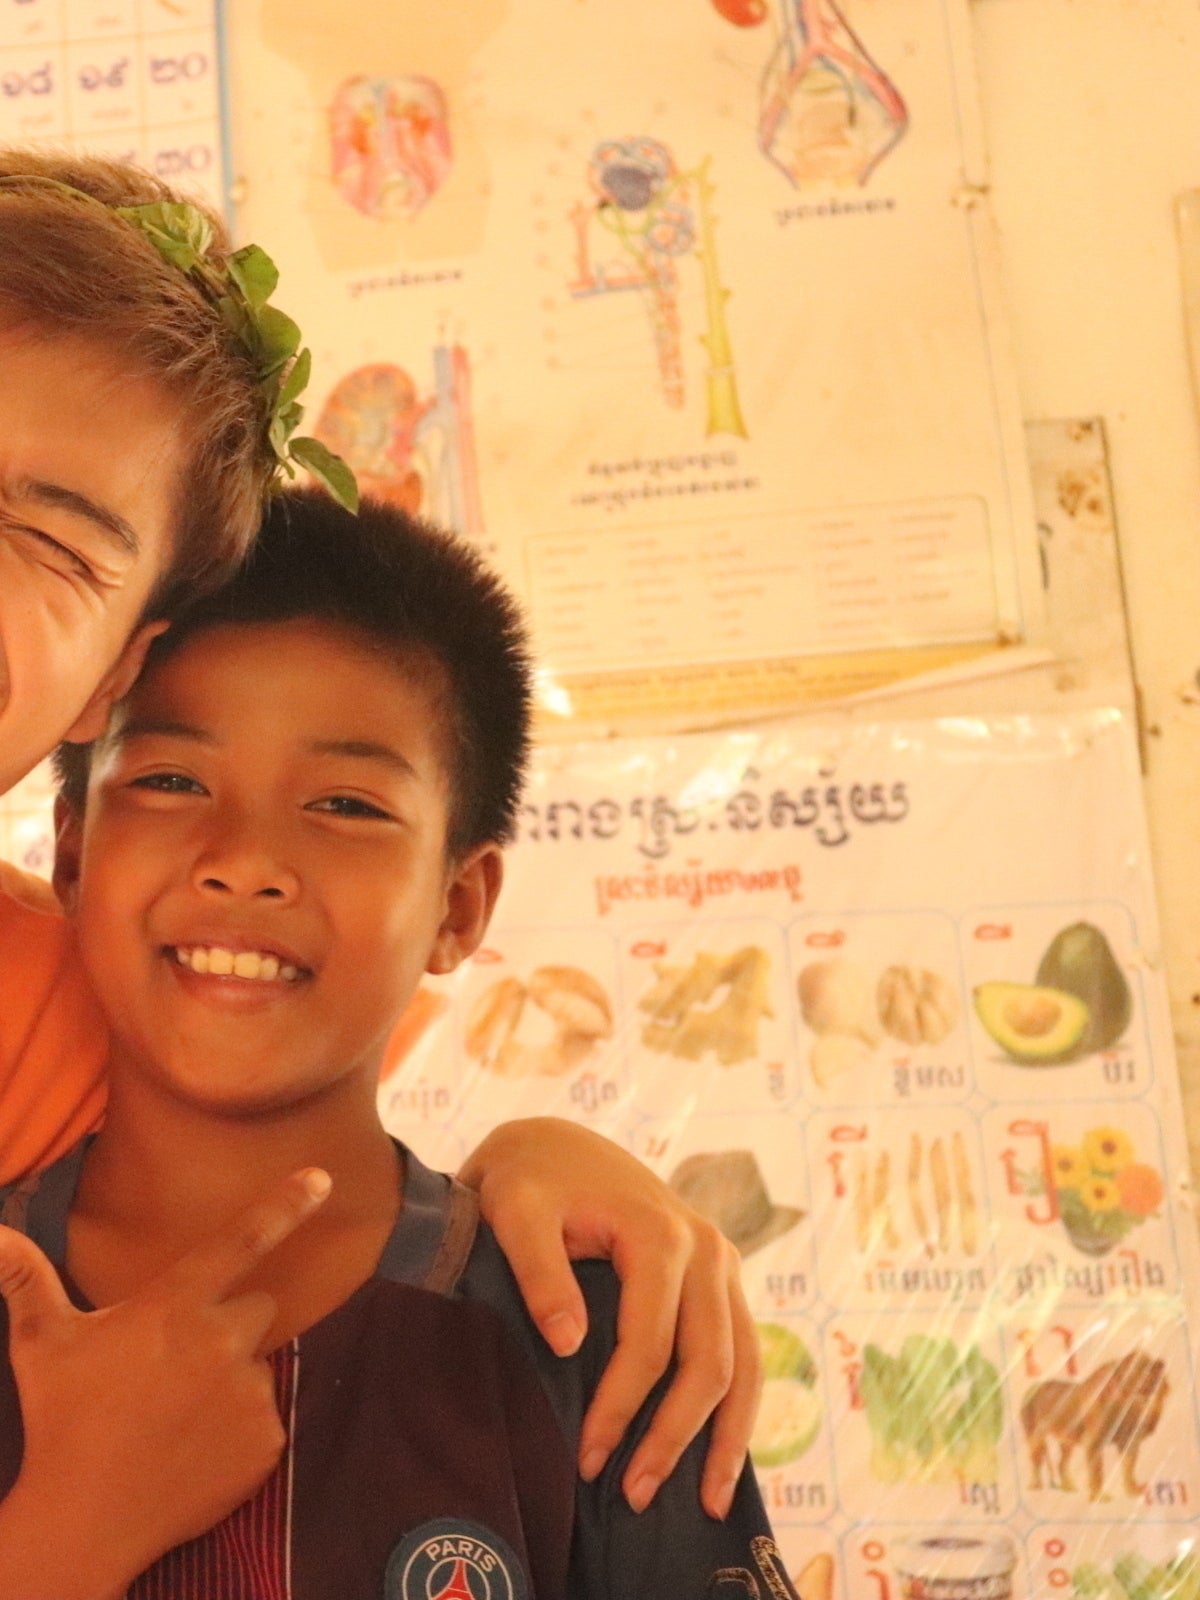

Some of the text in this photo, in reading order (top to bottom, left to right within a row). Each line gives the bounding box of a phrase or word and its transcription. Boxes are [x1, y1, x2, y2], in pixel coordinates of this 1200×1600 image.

[1, 60, 54, 98] ១៨
[78, 55, 130, 91] ១៩
[149, 51, 208, 84] ២០
[154, 145, 212, 176] ៣០
[425, 1539, 497, 1573] PARIS
